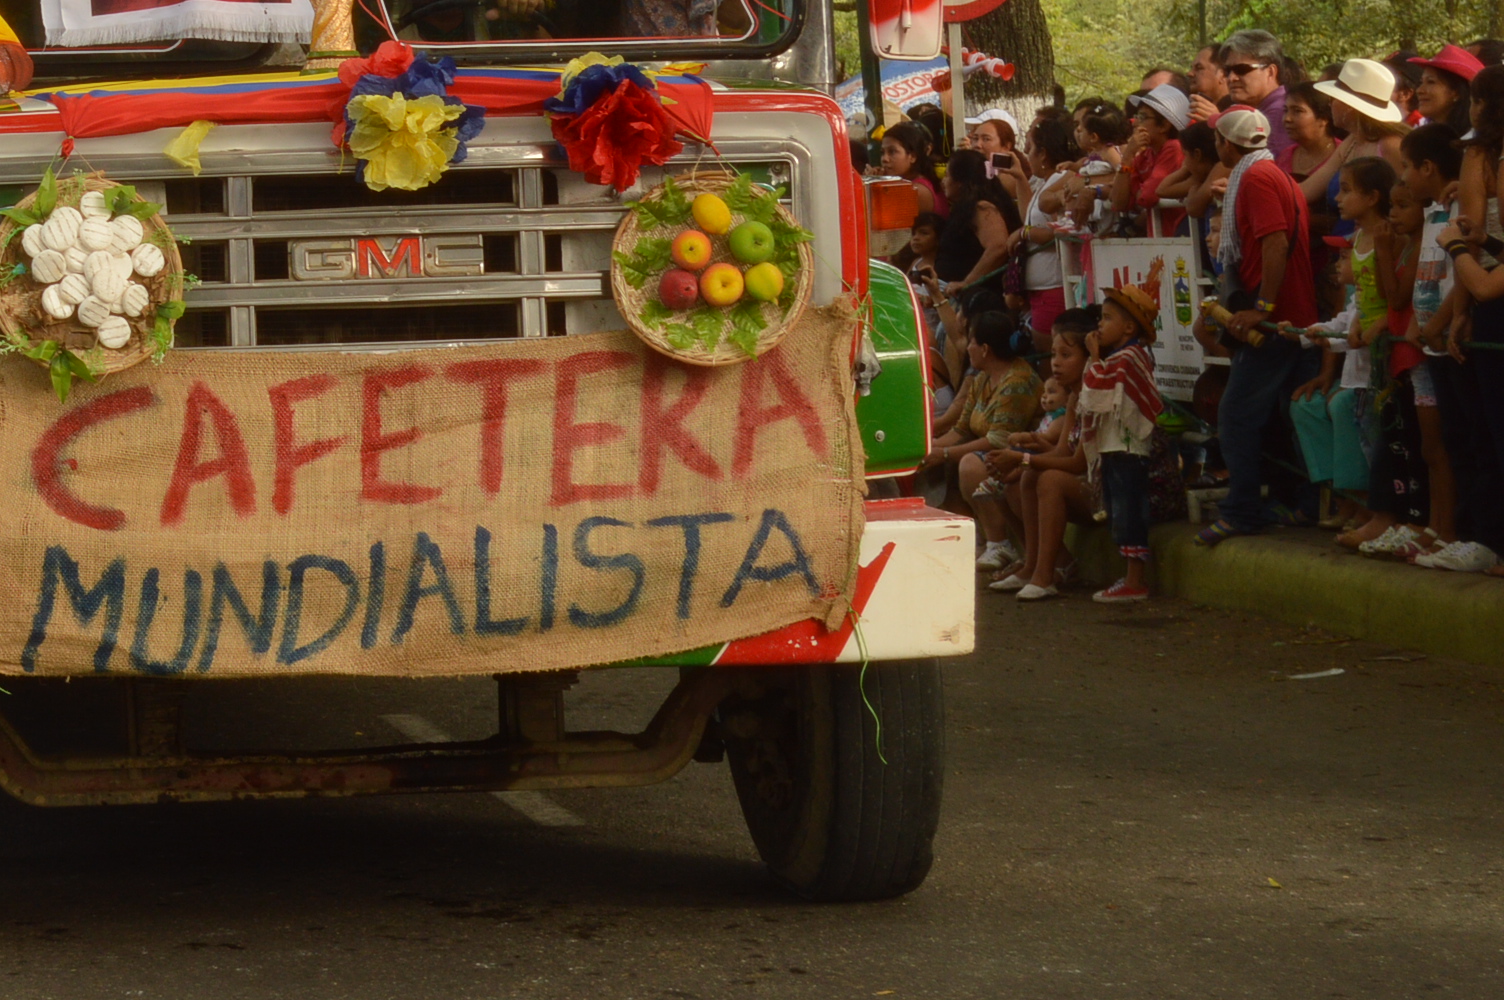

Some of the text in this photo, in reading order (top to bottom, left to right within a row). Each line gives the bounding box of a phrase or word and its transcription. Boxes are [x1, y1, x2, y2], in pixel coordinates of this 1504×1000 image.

[882, 70, 946, 99] OSTOB
[291, 234, 485, 281] GMC
[1156, 377, 1195, 389] INFRAESTRUCTUR
[31, 347, 831, 530] CAFETERA
[19, 508, 821, 675] MUNDIALISTA
